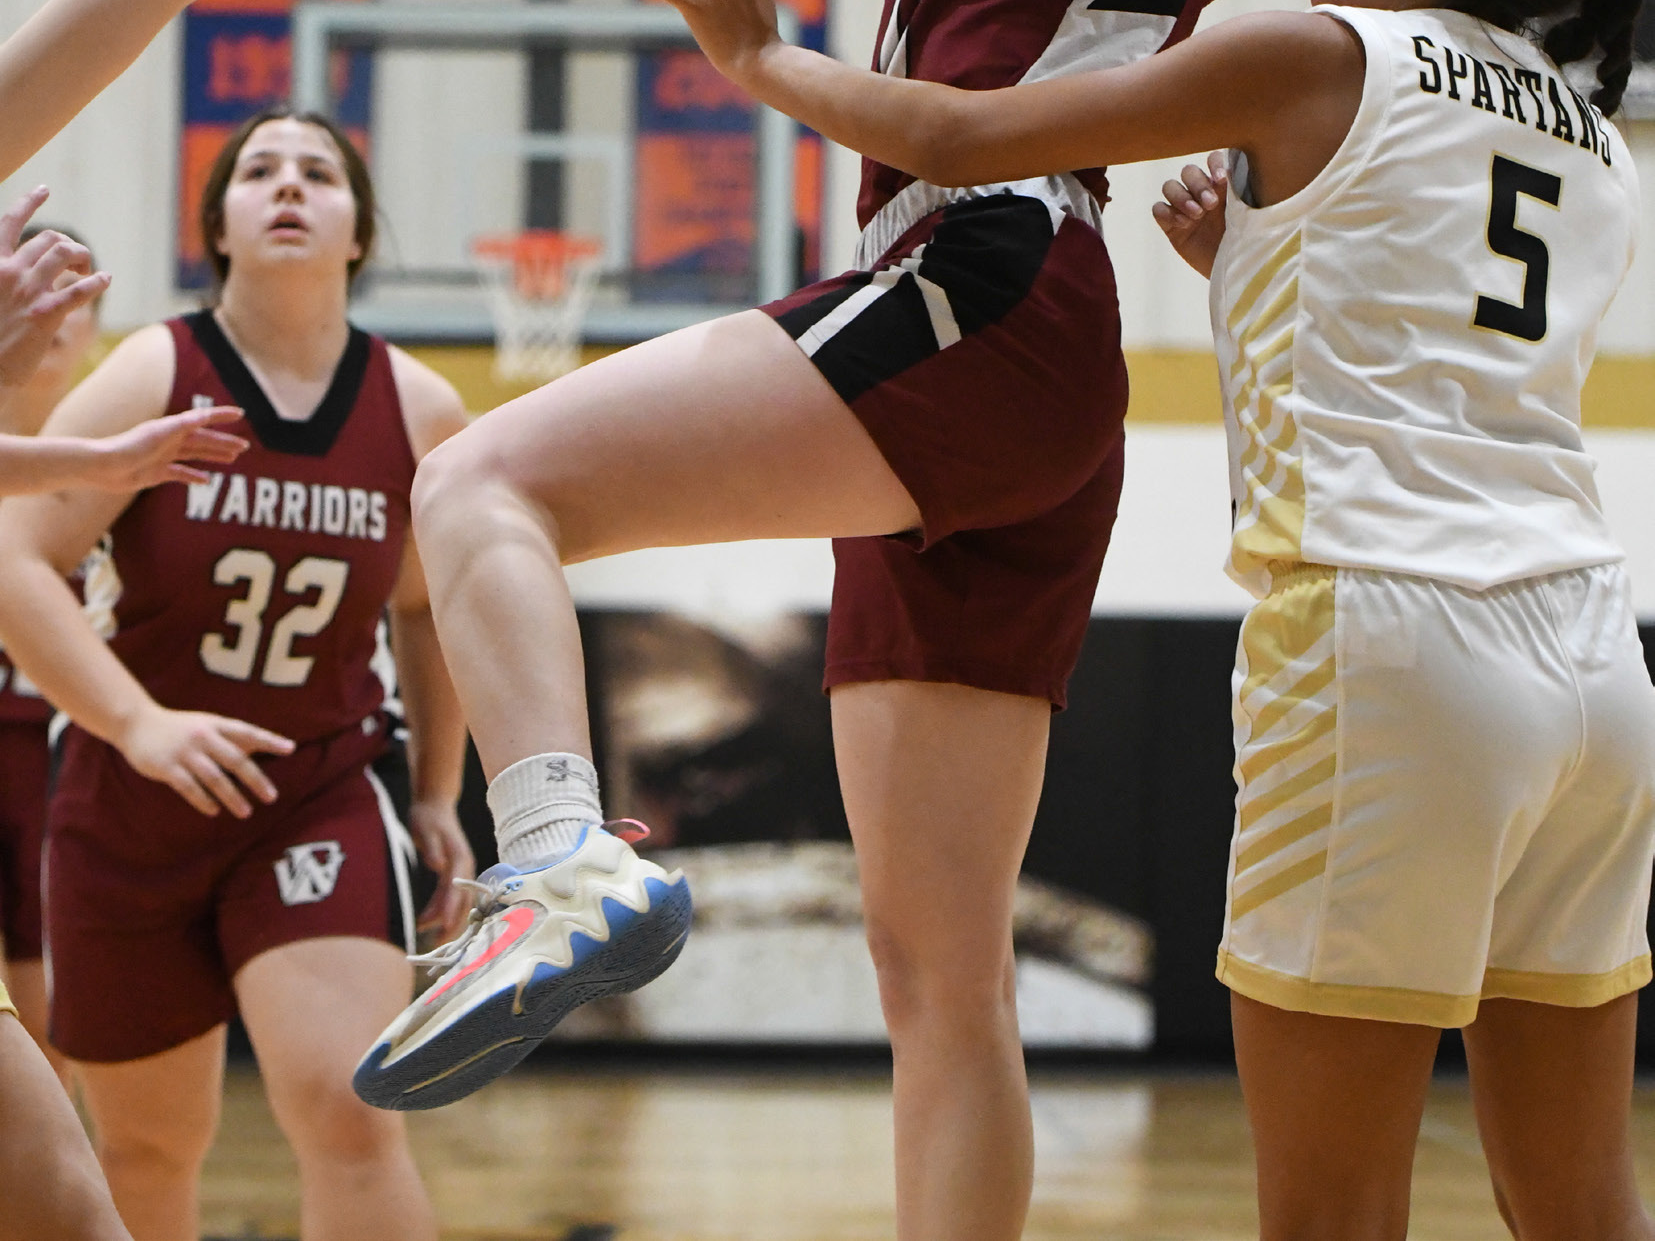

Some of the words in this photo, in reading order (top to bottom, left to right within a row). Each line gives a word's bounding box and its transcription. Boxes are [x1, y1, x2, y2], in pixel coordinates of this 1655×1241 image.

[1410, 35, 1612, 168] SPARTANS
[1470, 150, 1565, 346] 5
[186, 472, 387, 542] WARRIORS
[200, 548, 349, 687] 32
